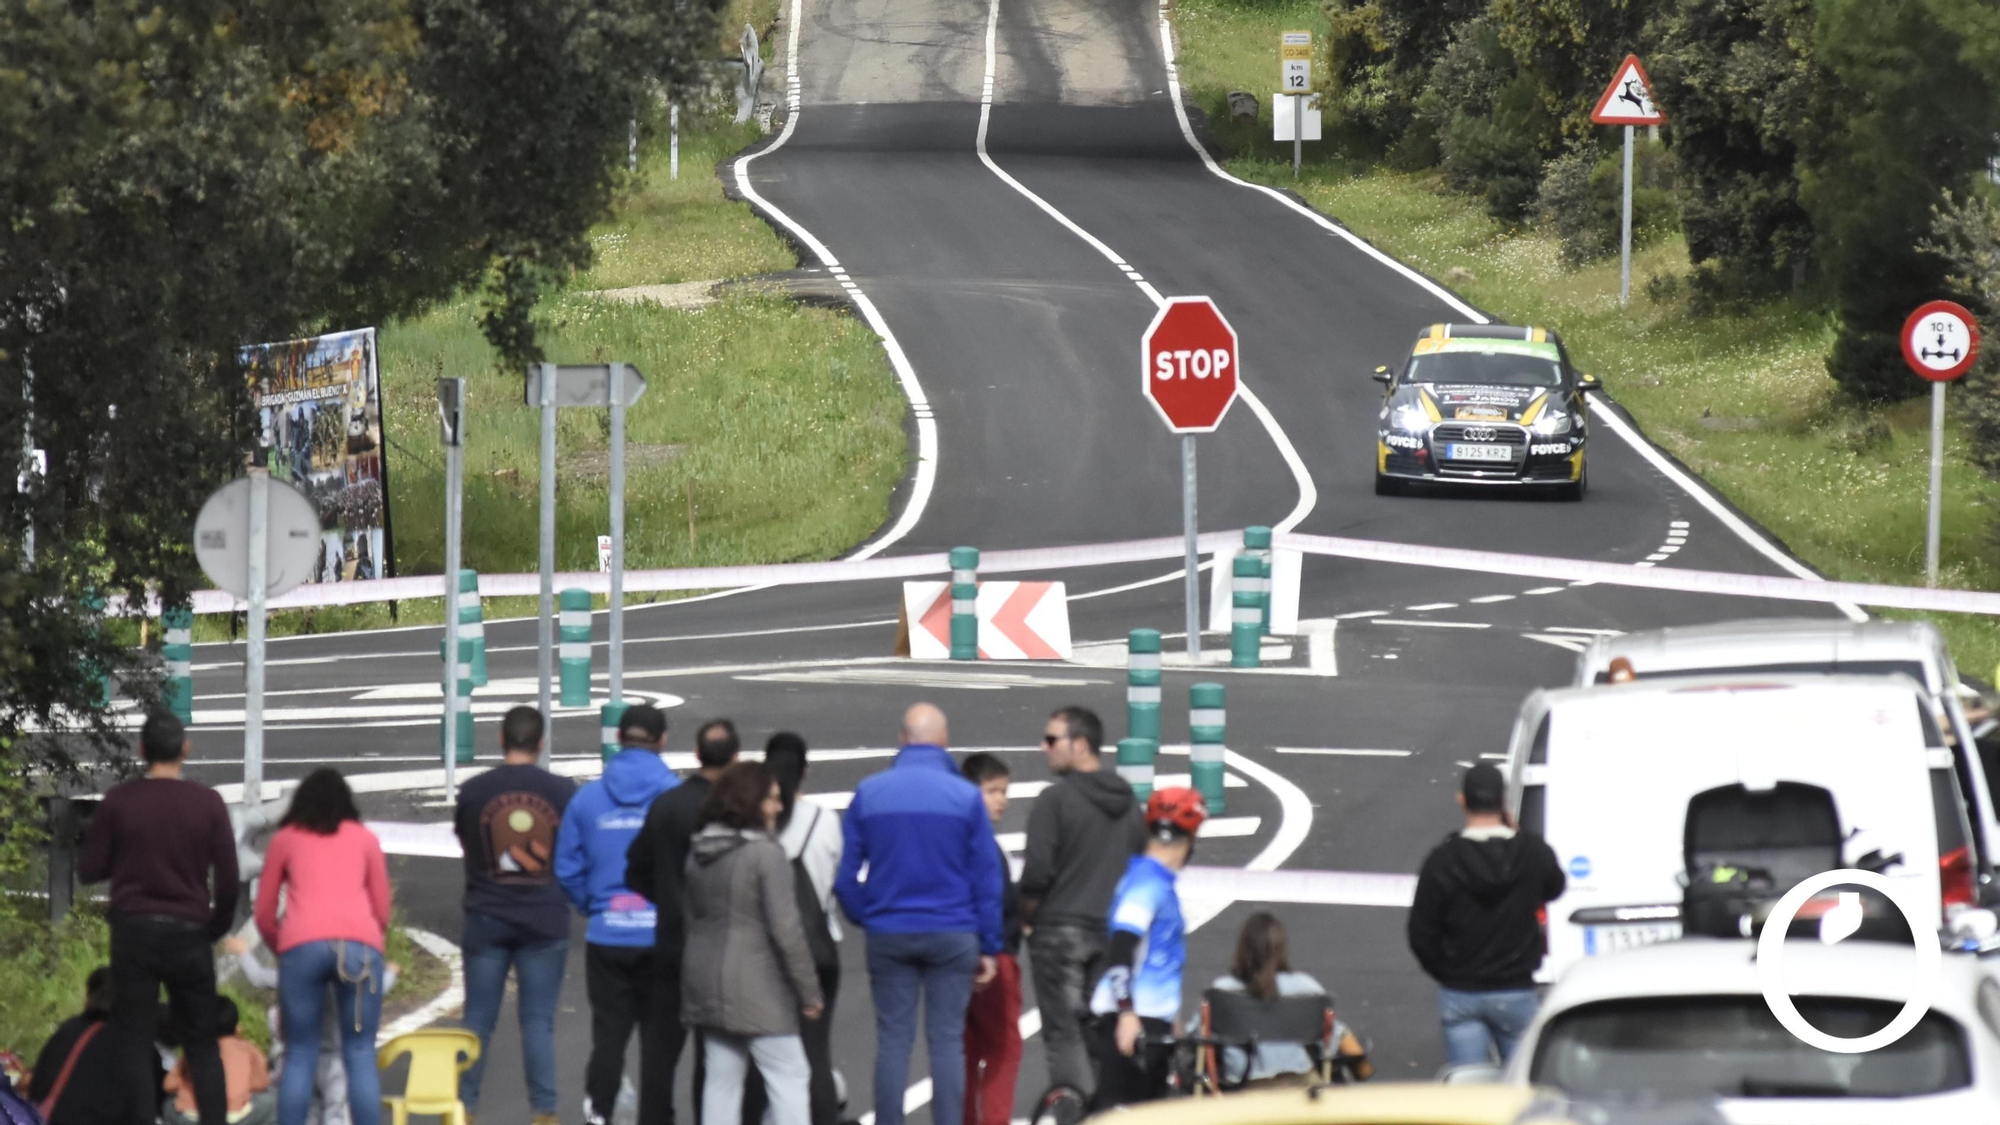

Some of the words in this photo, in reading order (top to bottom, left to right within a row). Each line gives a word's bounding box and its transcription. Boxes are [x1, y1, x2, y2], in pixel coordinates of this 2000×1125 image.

[1291, 63, 1303, 71] km
[1290, 75, 1304, 87] 12
[1931, 322, 1945, 332] 10
[1947, 323, 1954, 333] t
[1156, 349, 1230, 380] STOP
[261, 393, 285, 406] BRIGADA
[312, 388, 320, 399] EL
[342, 383, 348, 395] X
[1456, 446, 1484, 458] 9125
[1487, 448, 1507, 459] KRZ
[1531, 443, 1566, 455] FOYCE
